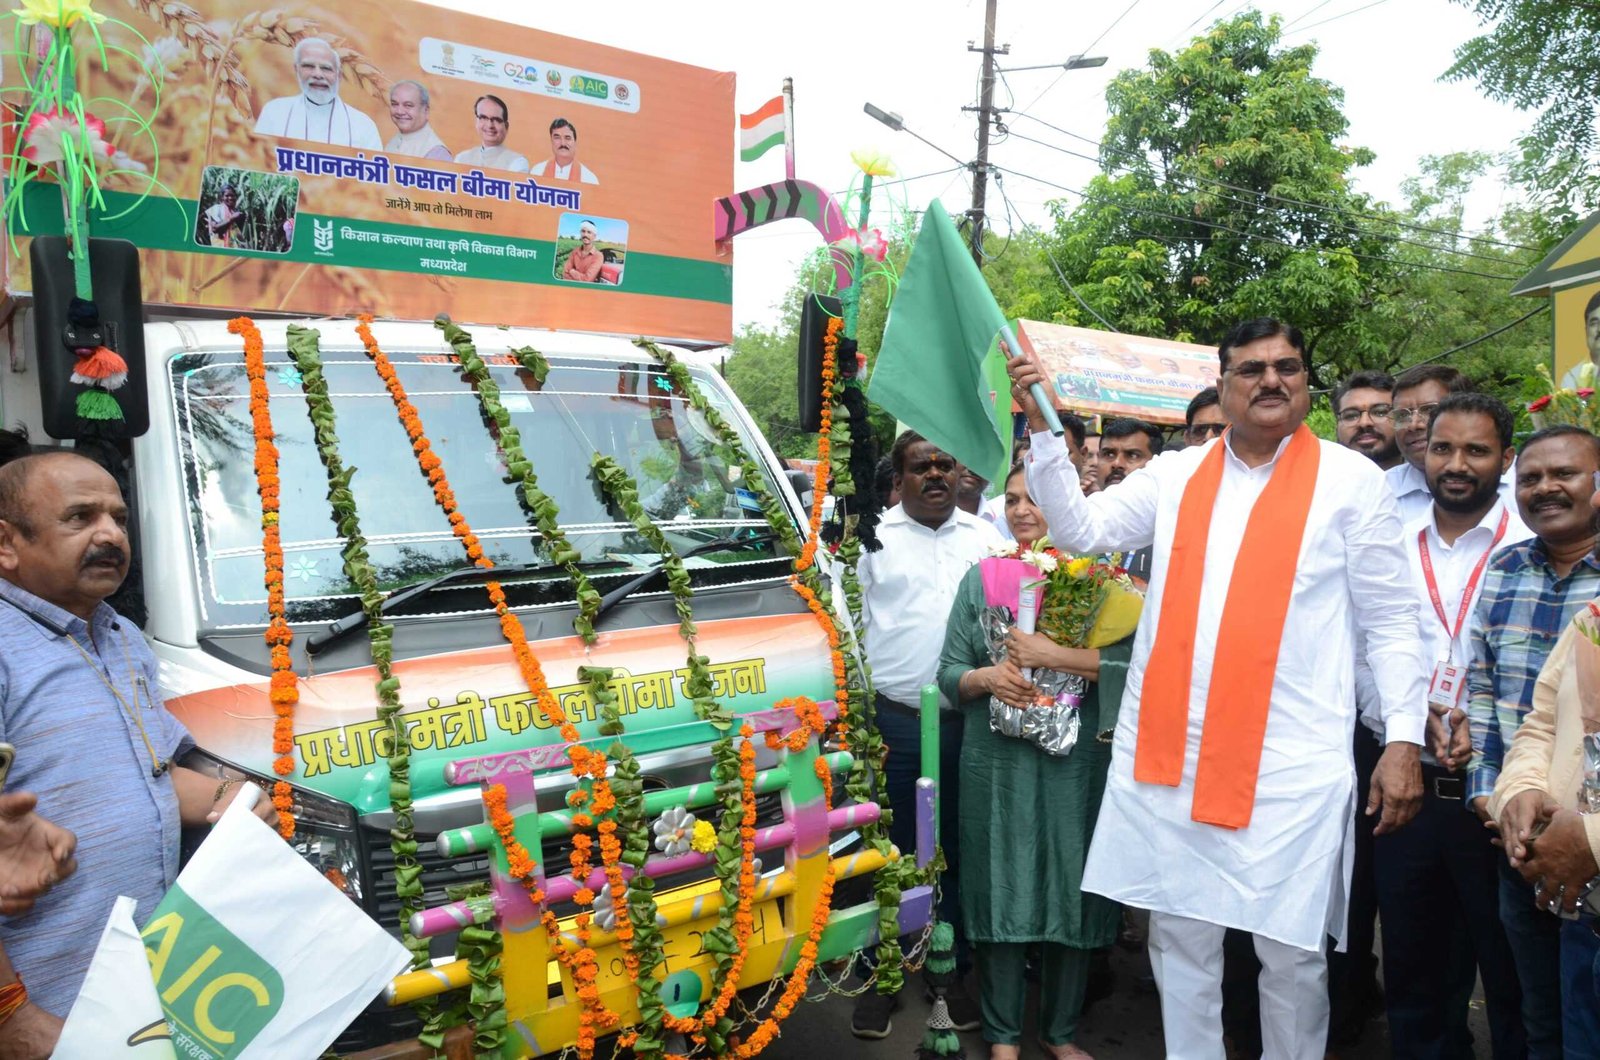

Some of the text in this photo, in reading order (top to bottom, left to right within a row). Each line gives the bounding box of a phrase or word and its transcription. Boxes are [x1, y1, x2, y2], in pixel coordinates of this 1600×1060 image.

[585, 80, 607, 94] AIC
[276, 148, 580, 210] प्रधानमंत्री फसल बीमा योजना
[385, 197, 493, 221] जानेंगे आप तो मिलेगा लाभ
[340, 226, 537, 259] किसान कल्याण तथा कृषि विकास विभाग
[420, 257, 467, 272] मध्यप्रदेश
[140, 911, 271, 1044] AIC
